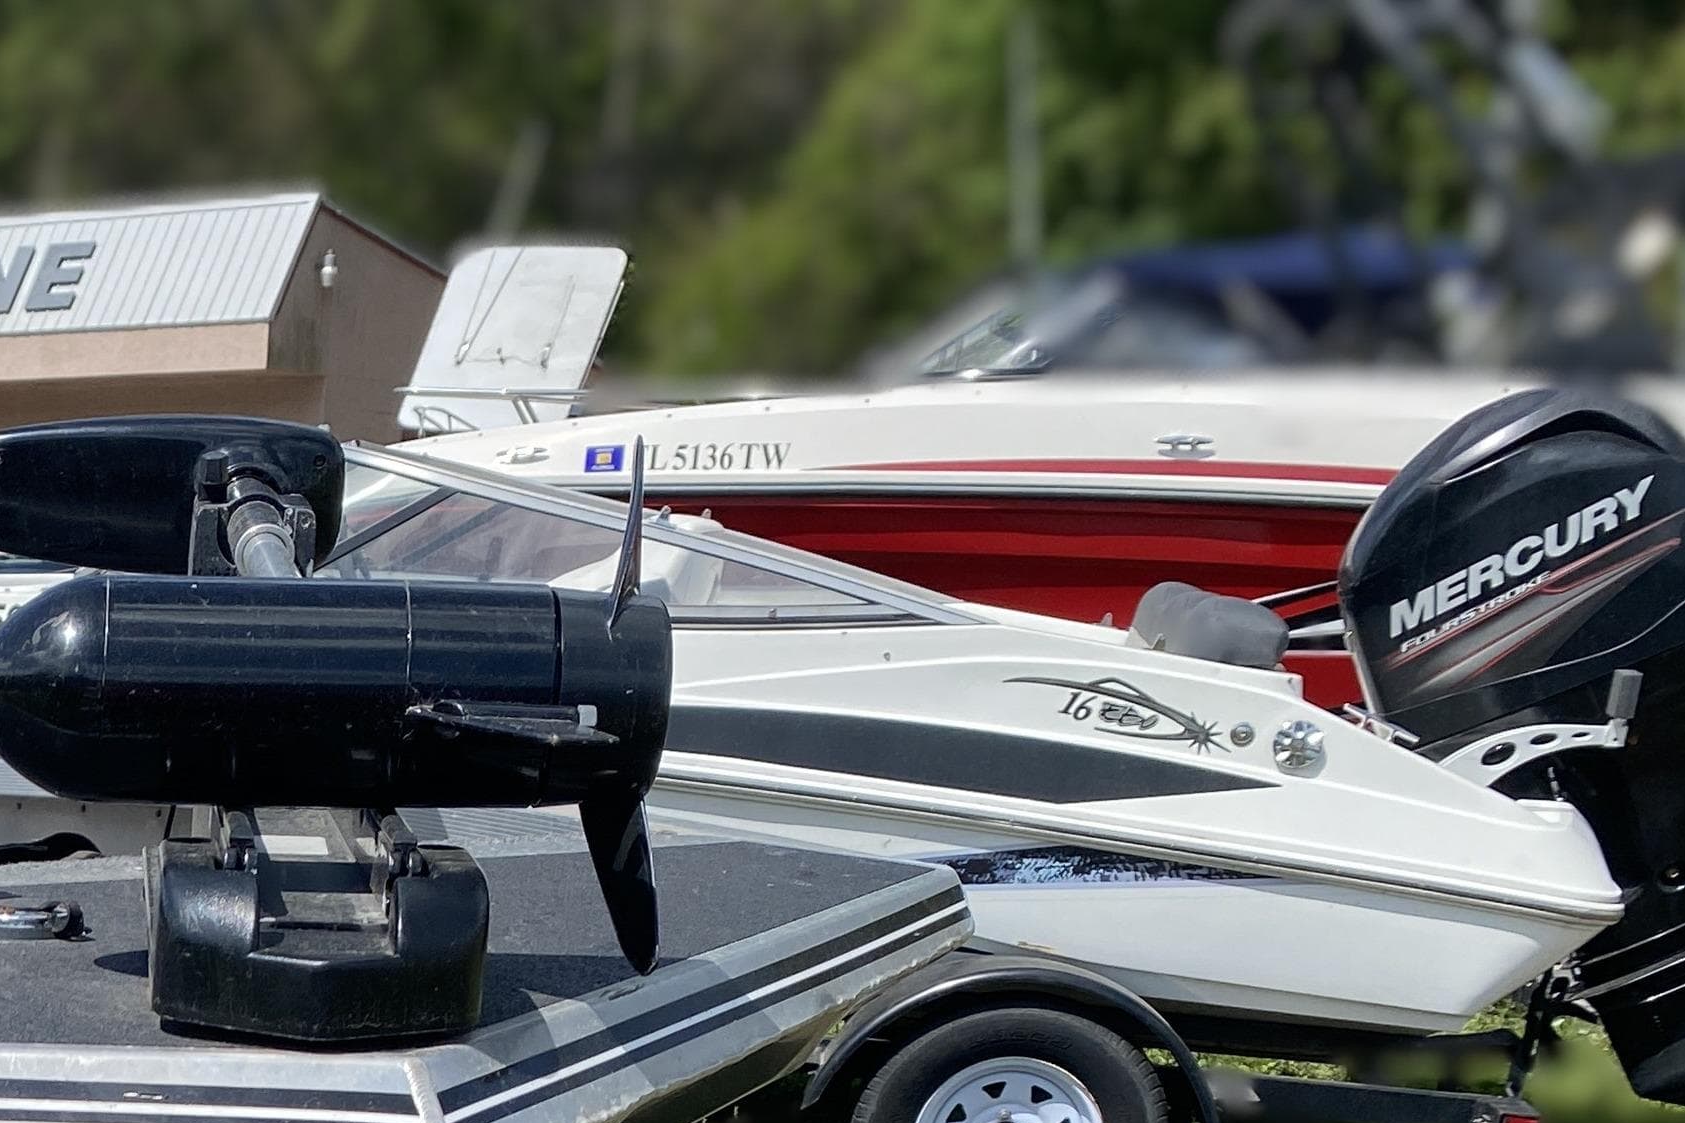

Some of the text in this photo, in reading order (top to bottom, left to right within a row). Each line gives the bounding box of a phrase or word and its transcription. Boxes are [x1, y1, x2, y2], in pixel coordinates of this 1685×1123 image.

[630, 442, 791, 471] L 5136 TW
[1389, 474, 1656, 640] MERCURY
[1399, 570, 1552, 653] FOURSTROKE
[1057, 690, 1098, 721] 16
